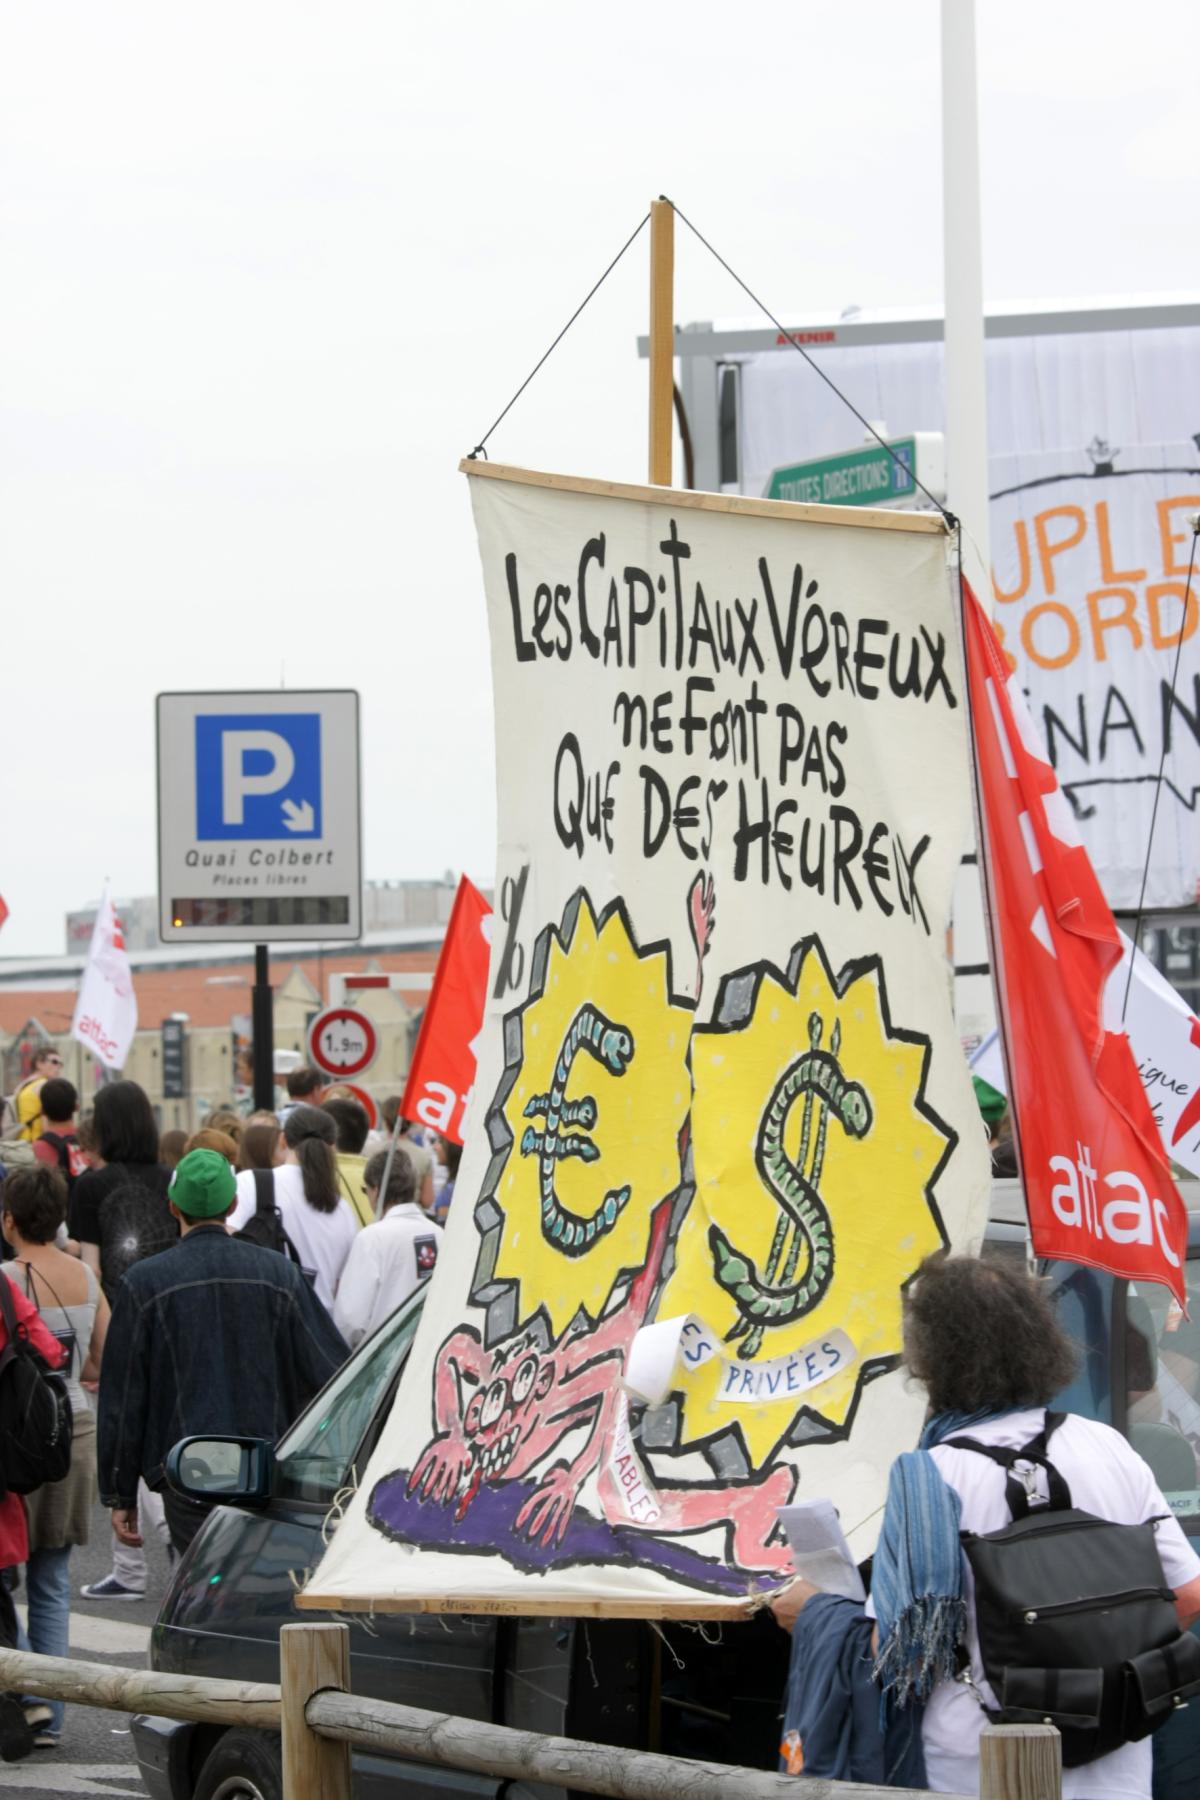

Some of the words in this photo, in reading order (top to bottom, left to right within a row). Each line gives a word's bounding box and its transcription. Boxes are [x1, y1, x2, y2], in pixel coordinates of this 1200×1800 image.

[779, 475, 821, 502] TOUTES
[823, 460, 889, 499] DIRECTIONS
[505, 552, 572, 662] Les
[776, 702, 848, 798] PAS
[221, 729, 296, 826] P
[185, 849, 237, 868] Quai
[249, 848, 334, 866] Colbert
[212, 874, 259, 886] Places
[266, 873, 308, 886] libres
[79, 1014, 118, 1060] attac
[1048, 1140, 1180, 1268] attac
[724, 1341, 842, 1396] PRIVÉES
[1167, 1499, 1193, 1509] ACIF
